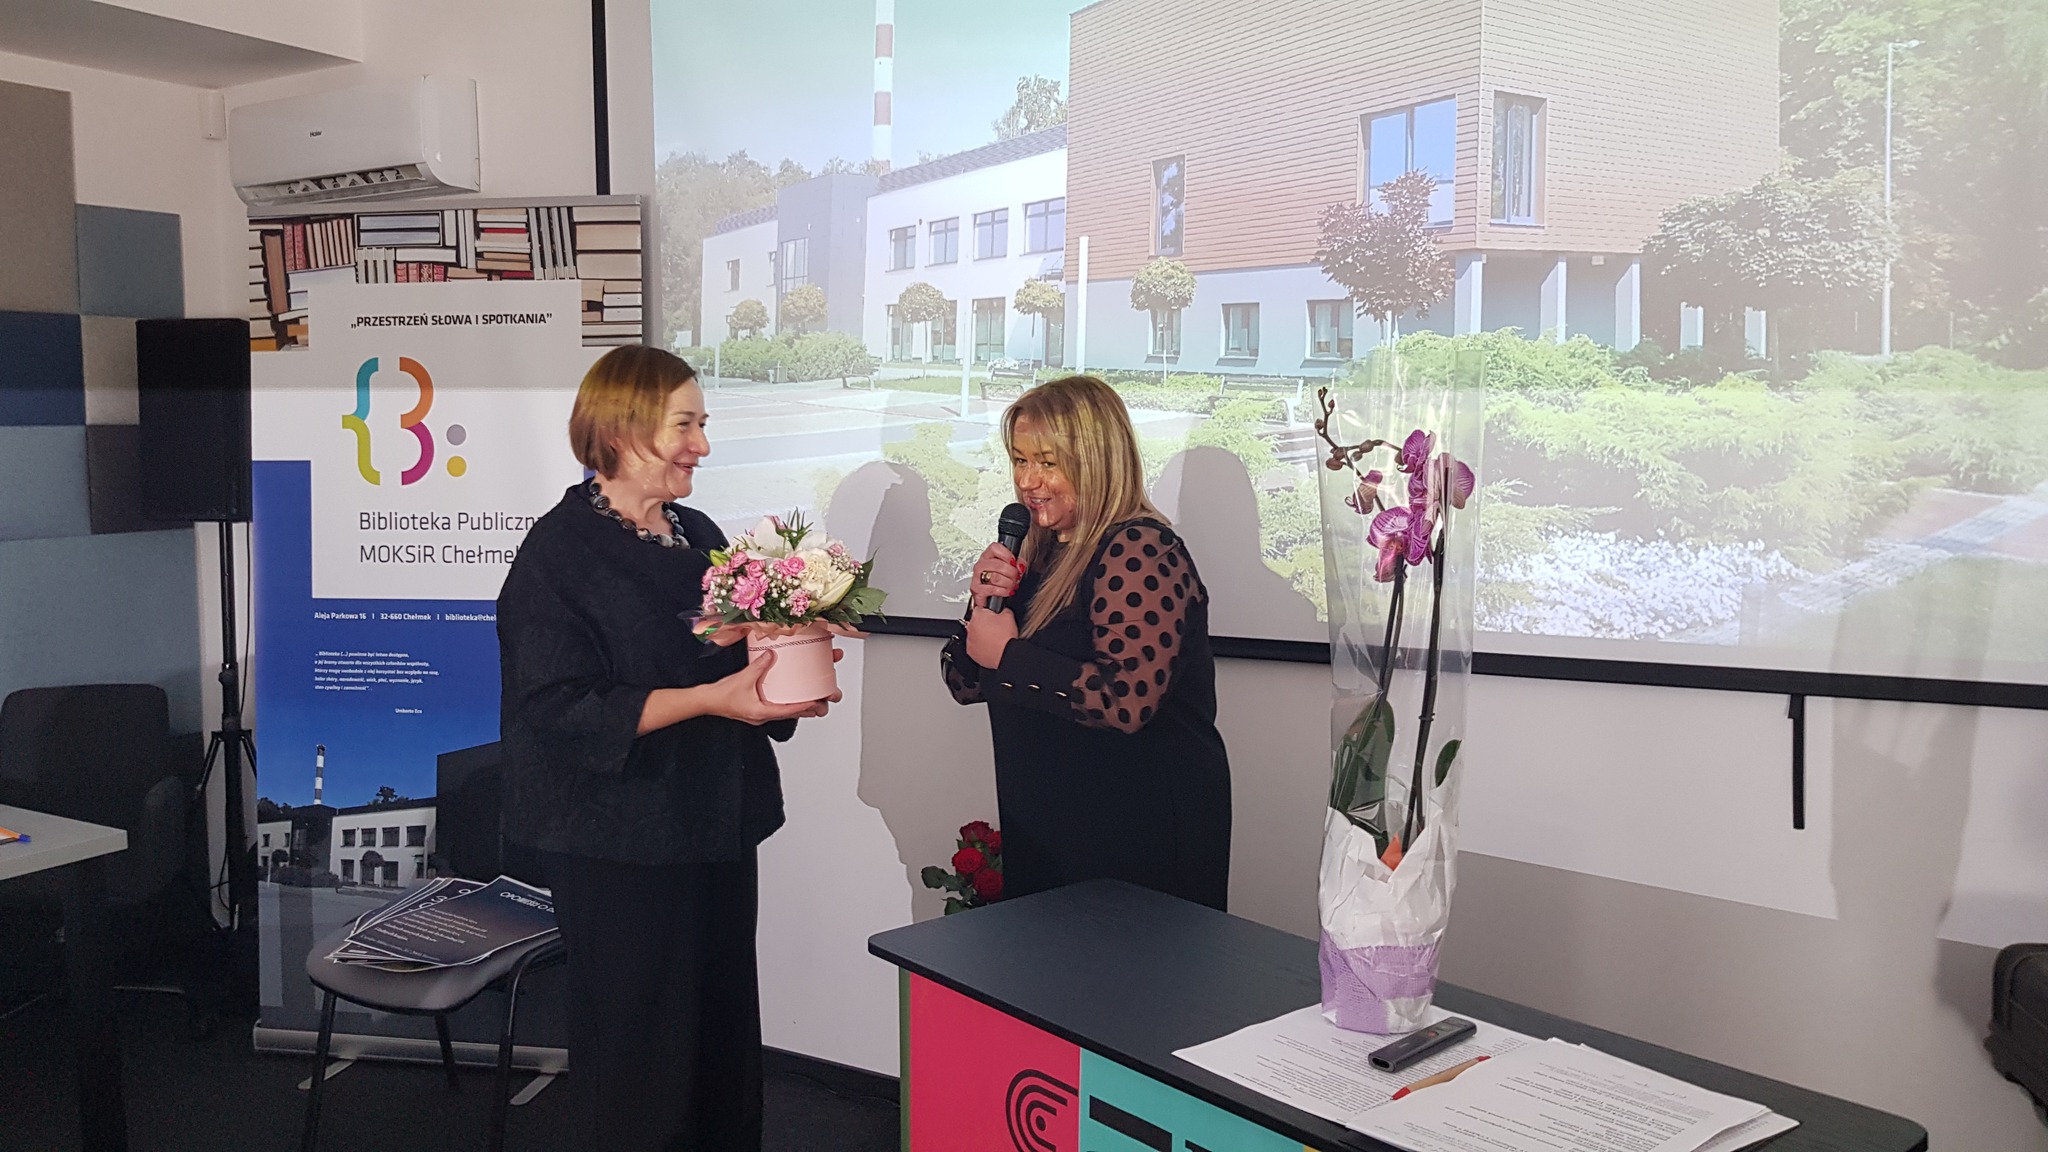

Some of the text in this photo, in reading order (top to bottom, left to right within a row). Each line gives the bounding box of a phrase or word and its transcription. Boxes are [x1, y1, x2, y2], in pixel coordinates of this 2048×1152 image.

[431, 314, 472, 326] SŁOWA
[475, 313, 478, 326] I
[360, 512, 544, 531] Biblioteka Publiczn
[360, 544, 436, 564] MOKSiR
[314, 612, 330, 620] Aleja
